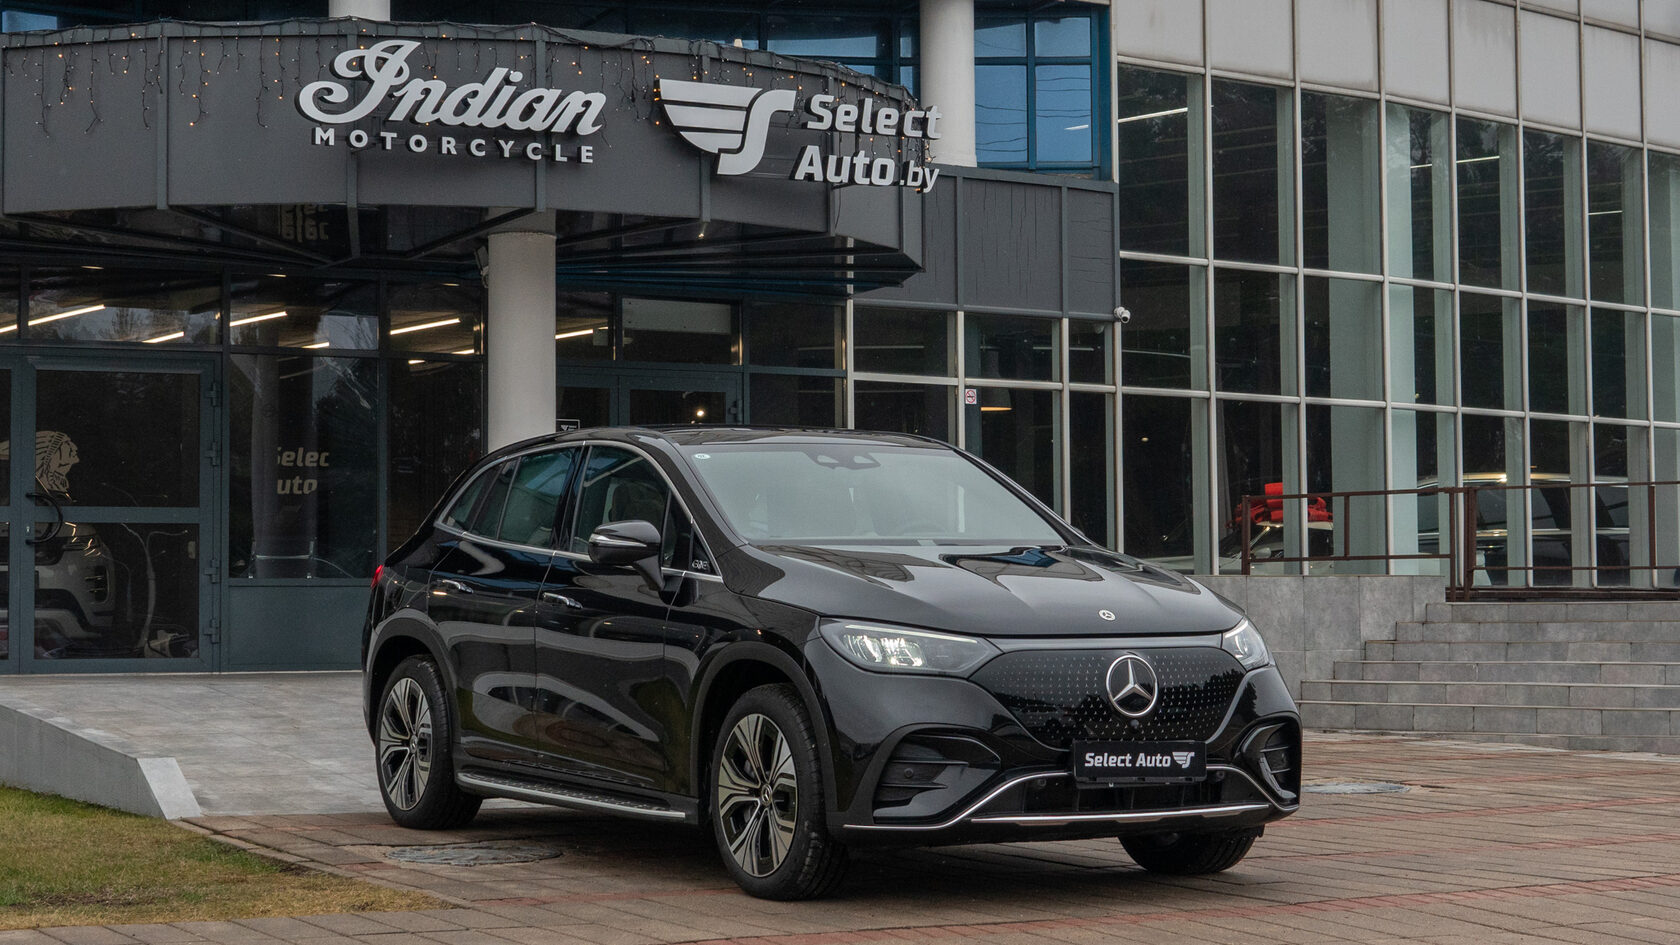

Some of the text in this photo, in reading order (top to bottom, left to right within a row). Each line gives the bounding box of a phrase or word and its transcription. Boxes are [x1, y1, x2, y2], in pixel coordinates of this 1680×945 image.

[298, 39, 606, 136] Indian
[806, 94, 943, 139] Select
[312, 126, 594, 163] MOTORCYCLE
[794, 145, 896, 186] Auto
[1084, 752, 1171, 767] Select Auto
